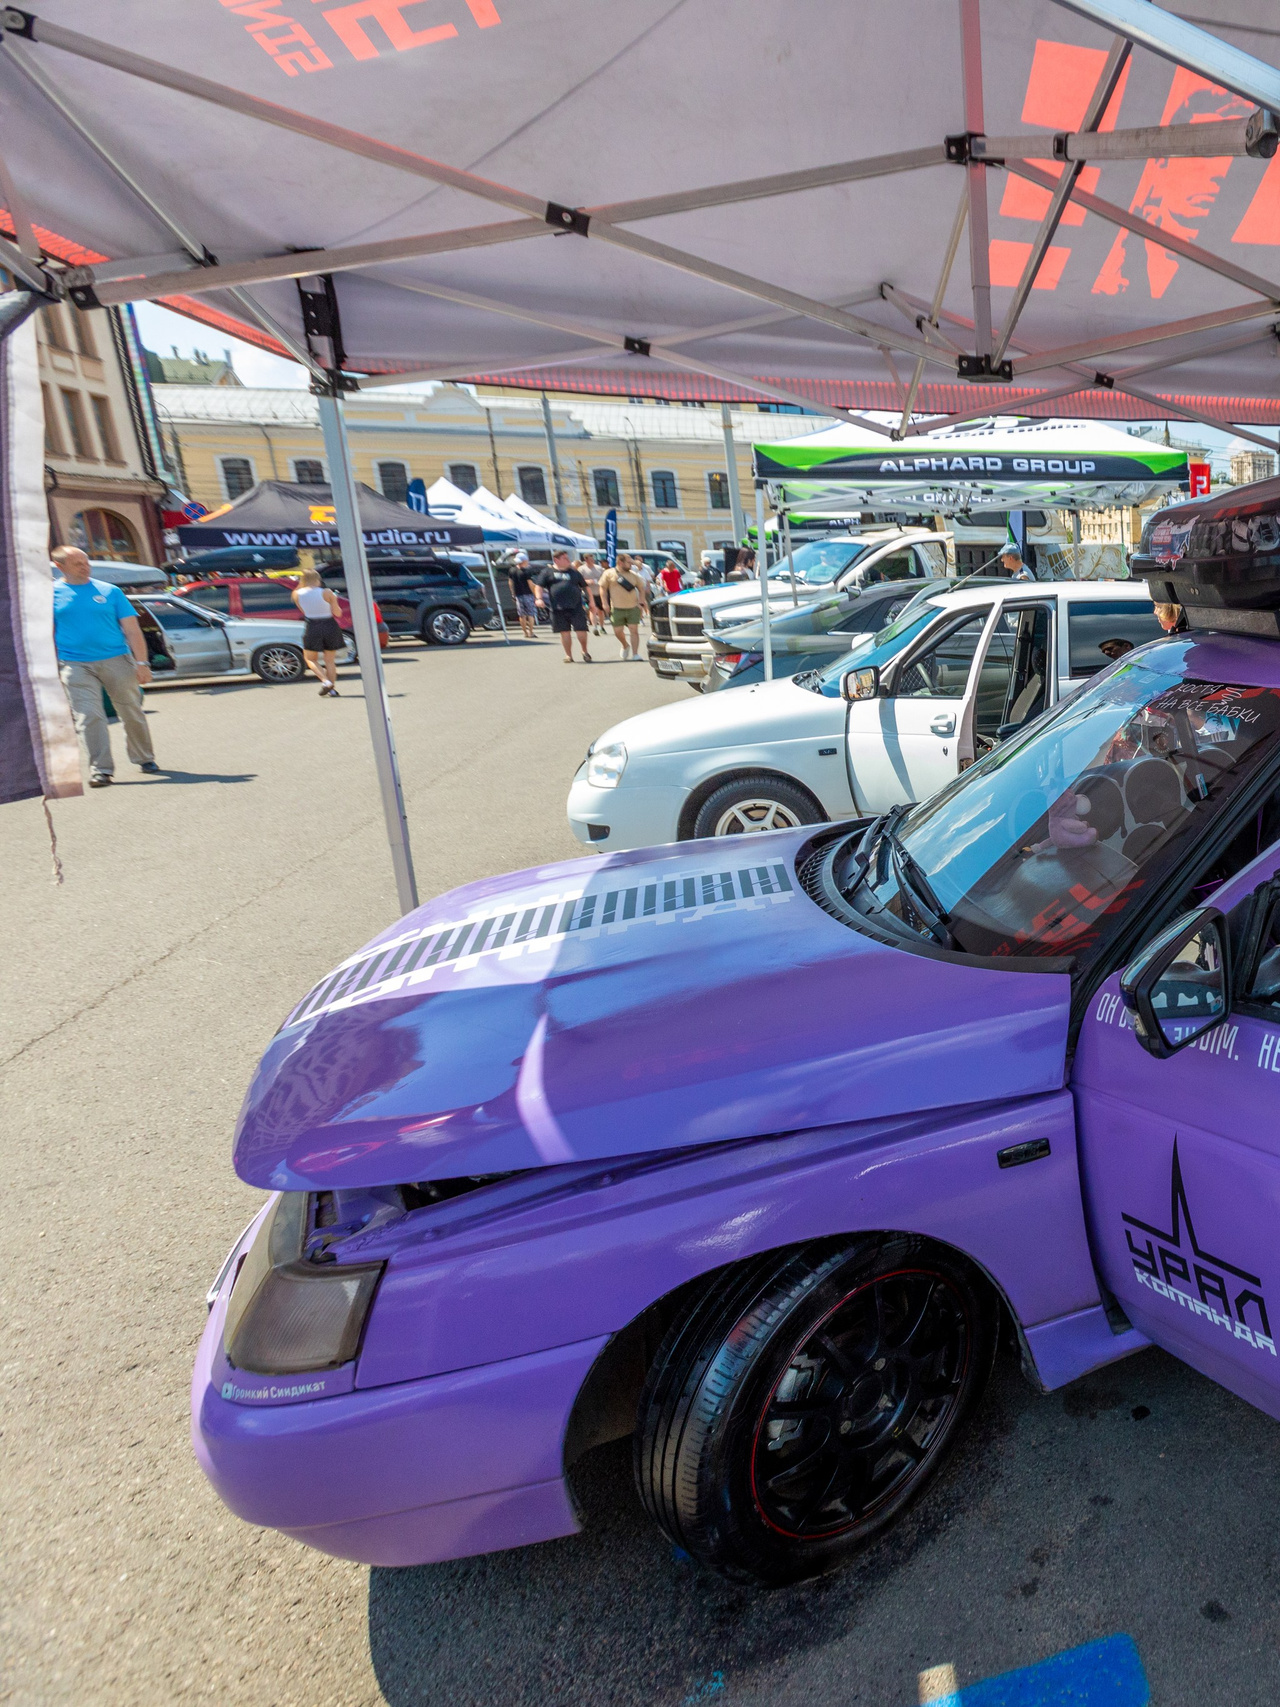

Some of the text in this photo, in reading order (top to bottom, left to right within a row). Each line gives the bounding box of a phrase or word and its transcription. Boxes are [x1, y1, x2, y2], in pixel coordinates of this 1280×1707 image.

[879, 456, 1096, 474] ALPHARD GROUP
[223, 529, 452, 546] www.dl-udio.ru
[1156, 696, 1261, 724] НА ВСЕ БАБКИ
[270, 1381, 326, 1399] Синдикат
